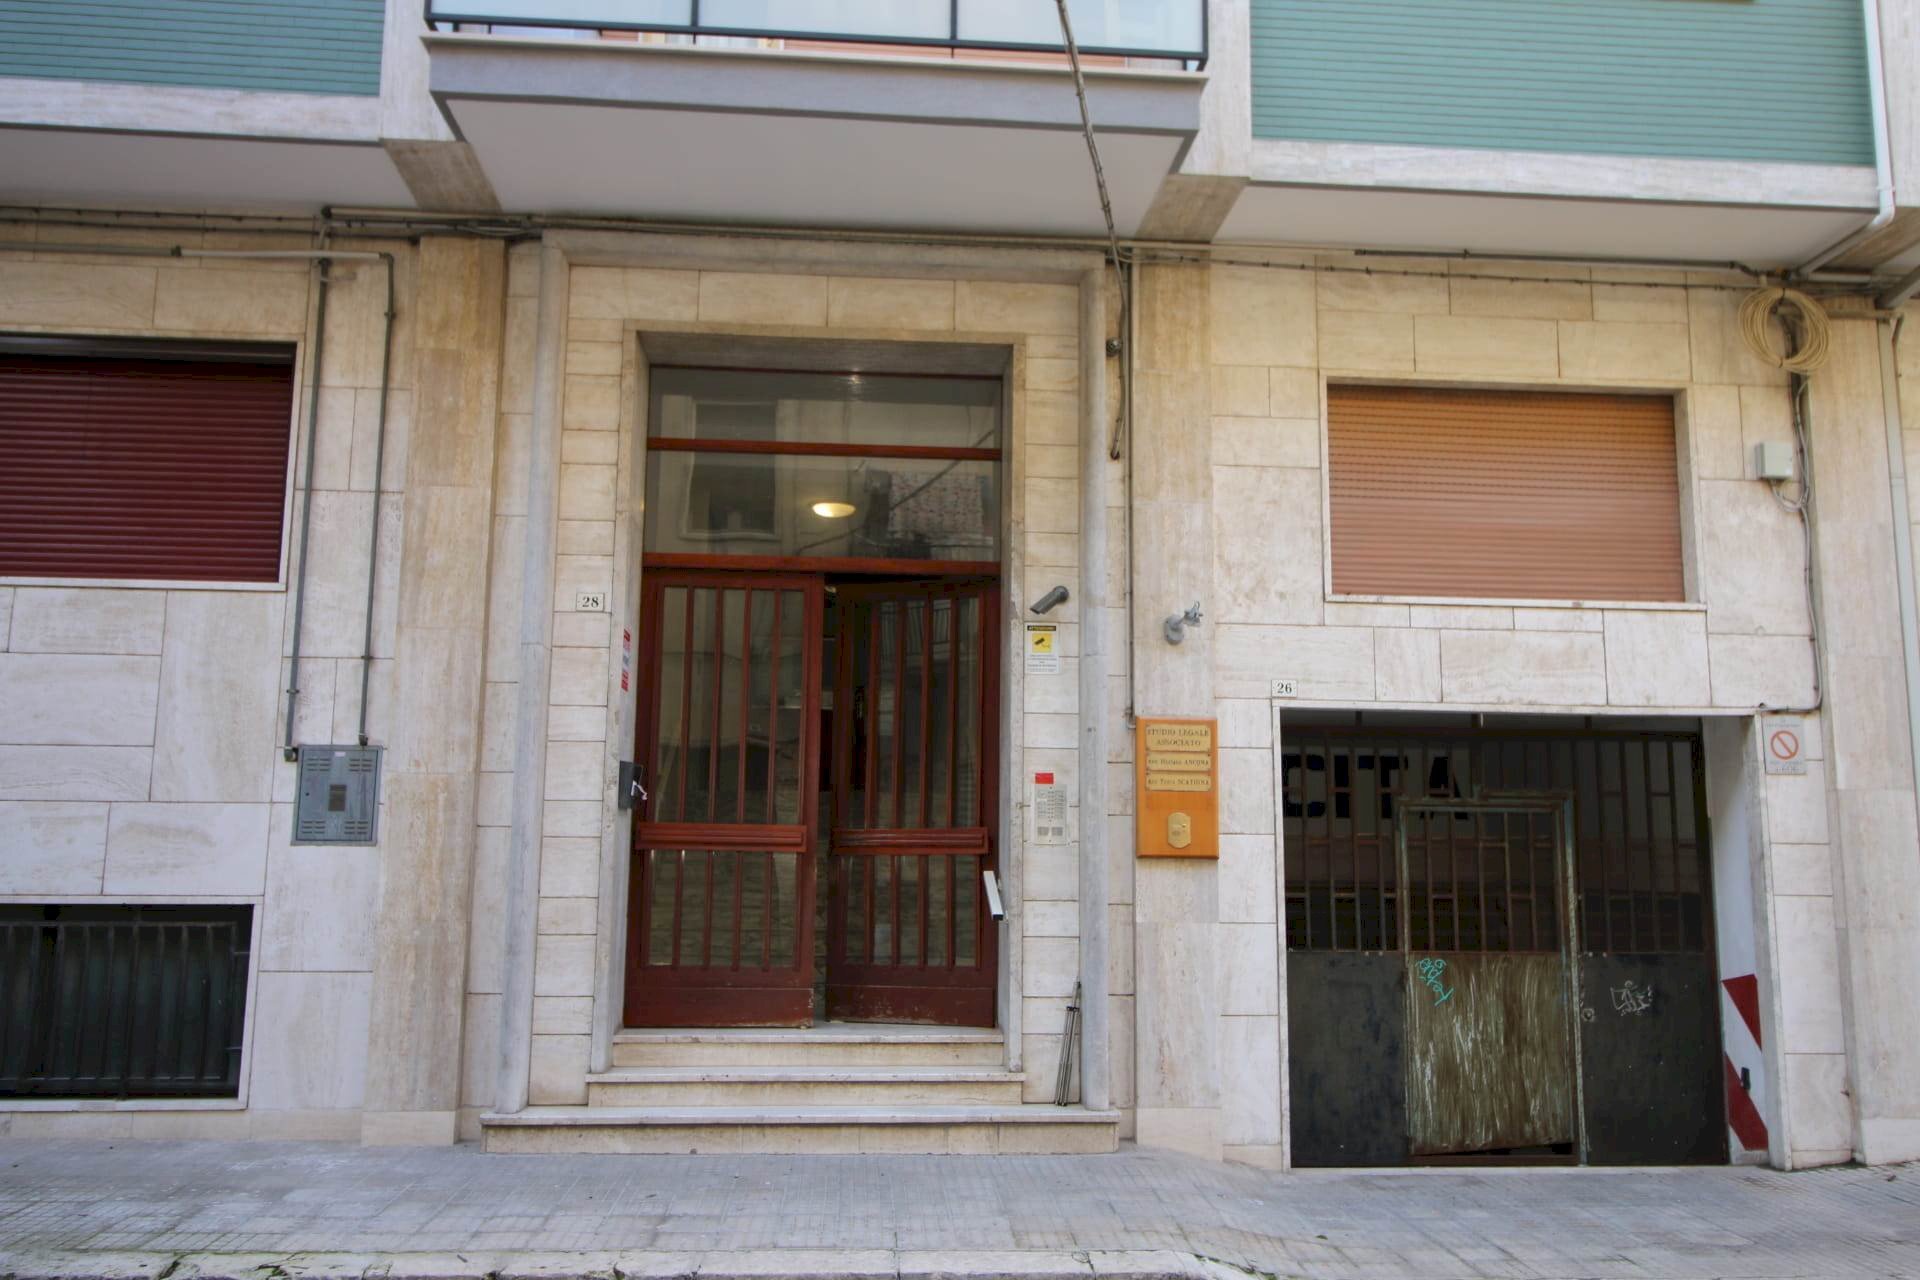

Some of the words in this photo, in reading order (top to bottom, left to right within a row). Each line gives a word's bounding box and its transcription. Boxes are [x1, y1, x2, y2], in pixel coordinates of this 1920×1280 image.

[582, 596, 599, 608] 28
[1277, 682, 1292, 694] 26
[1147, 728, 1176, 736] STUDIO
[1178, 728, 1209, 737] LEGALE
